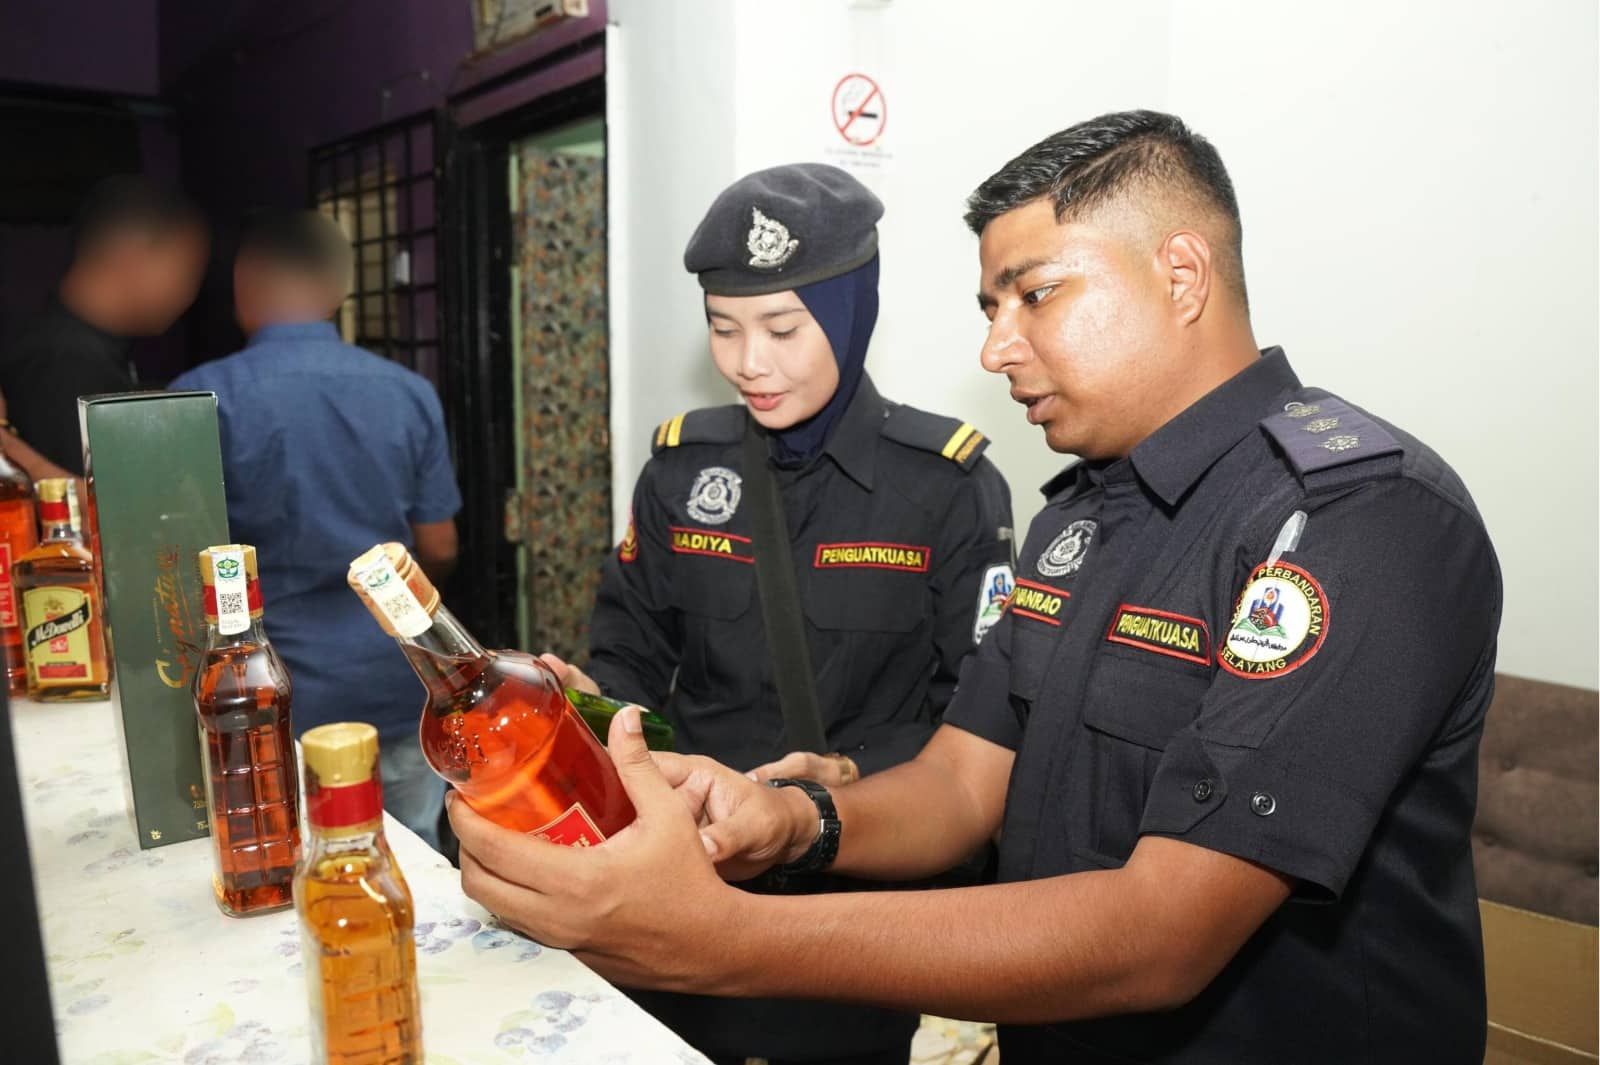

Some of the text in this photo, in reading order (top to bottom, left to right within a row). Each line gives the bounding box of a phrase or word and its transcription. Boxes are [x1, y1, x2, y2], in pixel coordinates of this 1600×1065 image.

[821, 547, 922, 566] PENGUATKUASA
[1258, 567, 1322, 635] PERBANDARAN
[1116, 613, 1199, 652] PENGUATKUASA
[1221, 646, 1286, 673] SELAYANG
